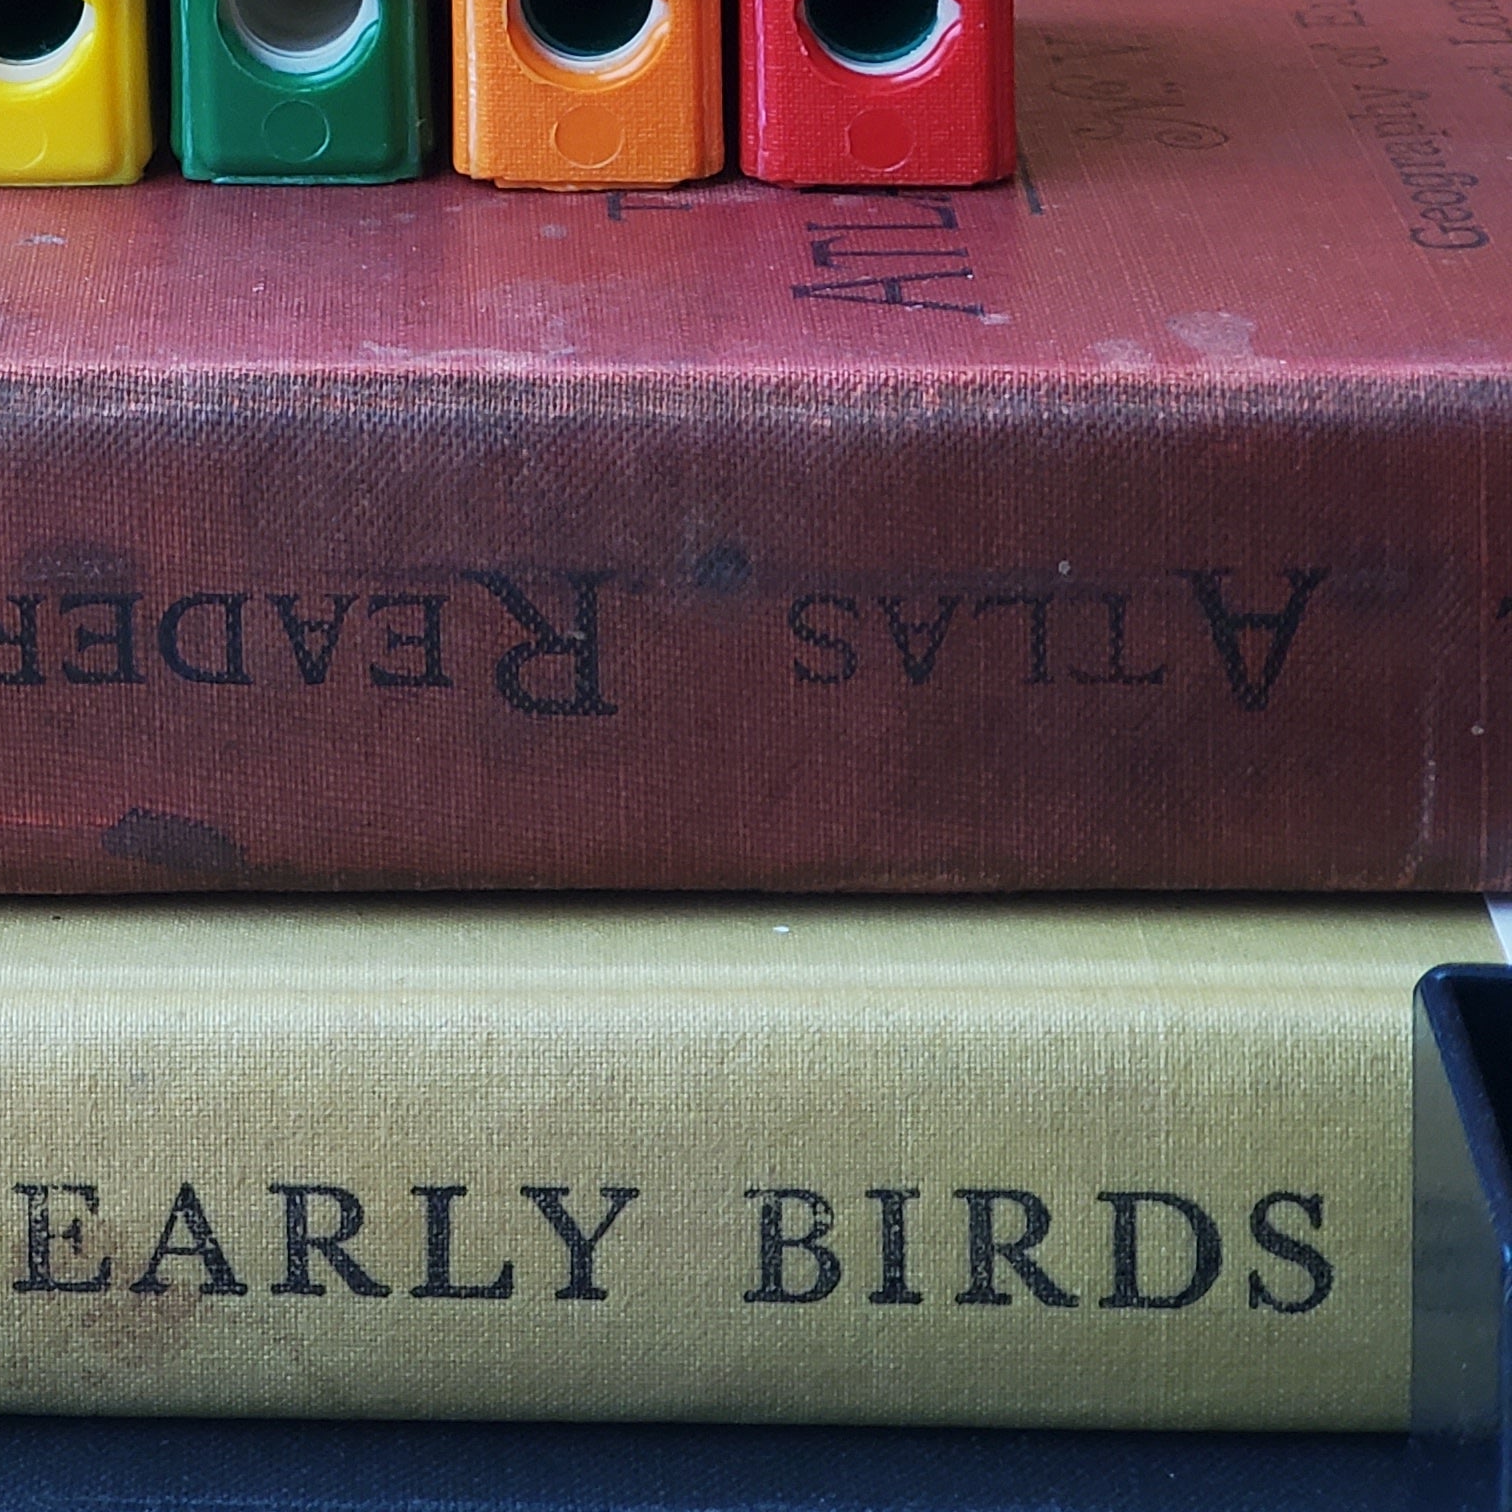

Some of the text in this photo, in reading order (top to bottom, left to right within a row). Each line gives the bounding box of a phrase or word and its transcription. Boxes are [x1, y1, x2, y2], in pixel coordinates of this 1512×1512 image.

[1308, 41, 1389, 69] of
[1346, 83, 1490, 249] Geography
[788, 568, 1330, 712] ATLAS
[12, 1180, 641, 1301] EARLY
[742, 1185, 1336, 1314] BIRDS
